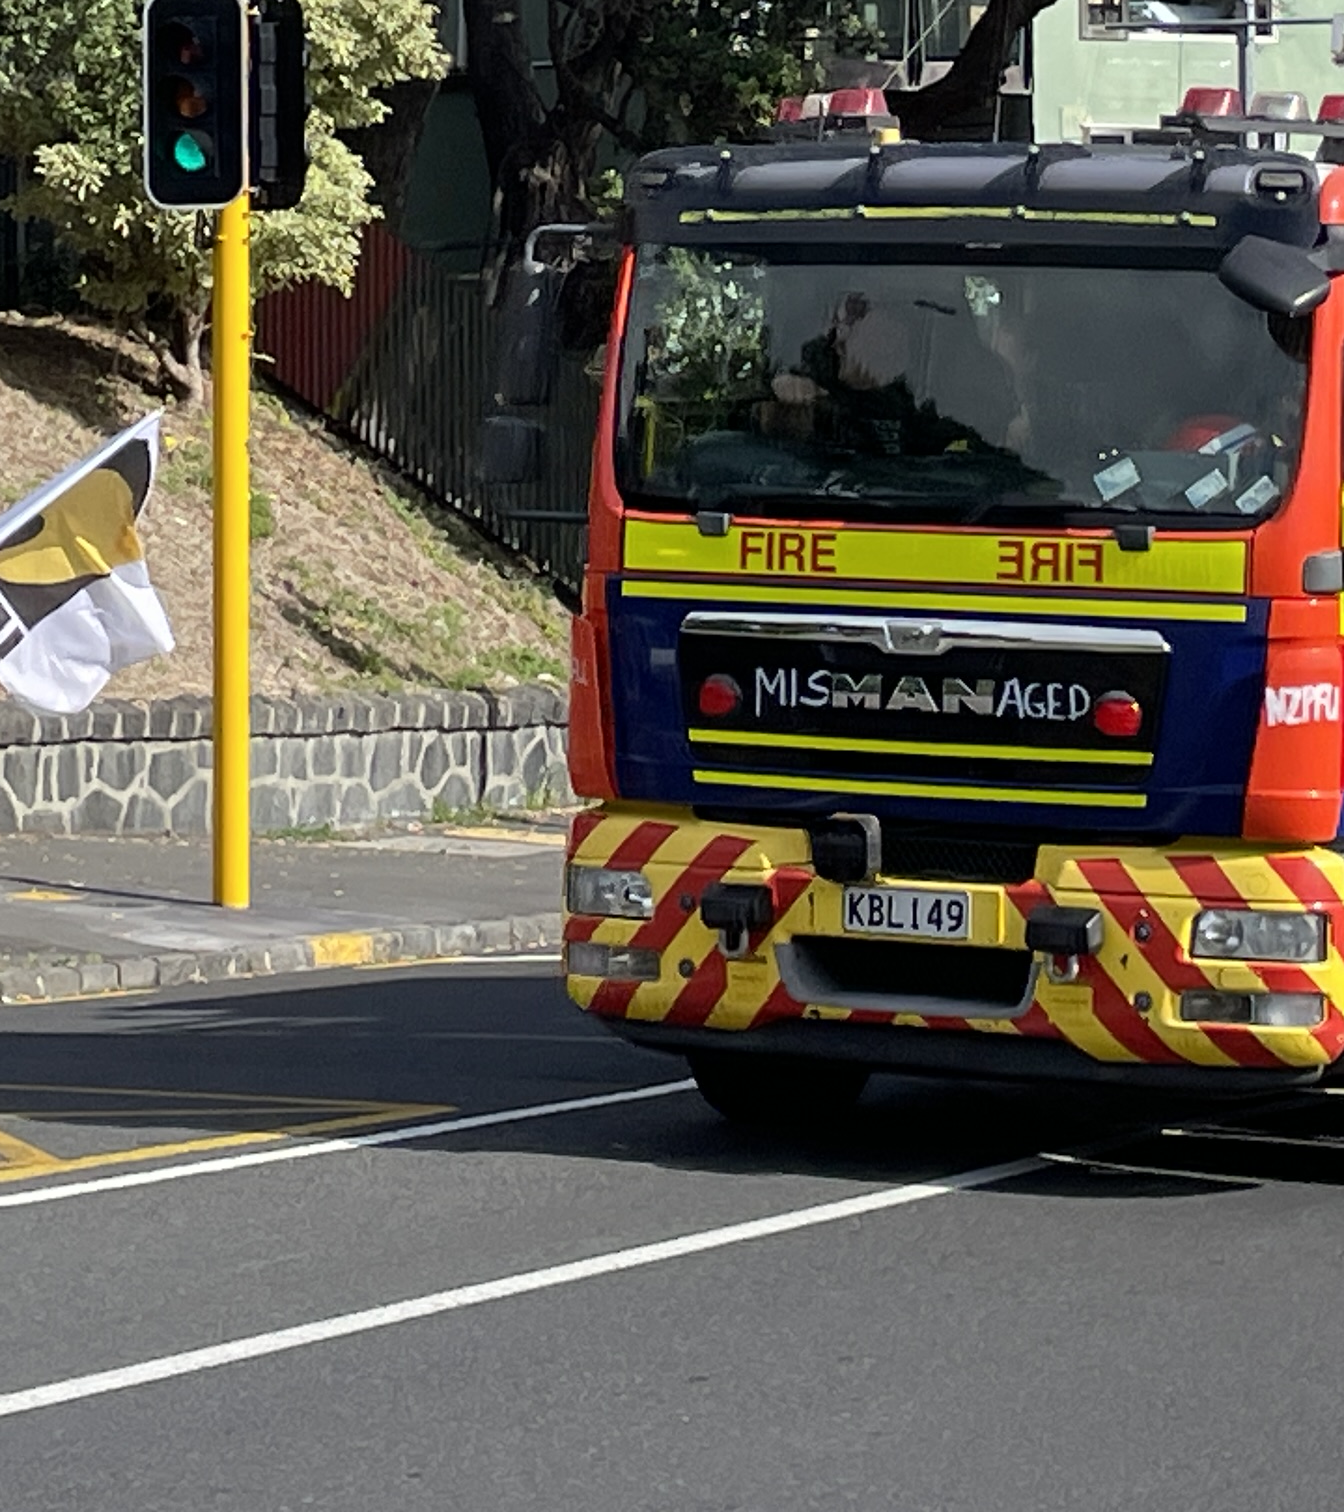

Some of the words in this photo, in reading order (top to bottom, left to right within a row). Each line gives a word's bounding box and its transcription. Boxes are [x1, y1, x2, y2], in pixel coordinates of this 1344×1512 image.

[740, 531, 838, 573] FIRE
[755, 667, 1091, 722] MISMANAGED
[1265, 683, 1339, 727] NZPFU
[848, 892, 964, 932] KBL149
